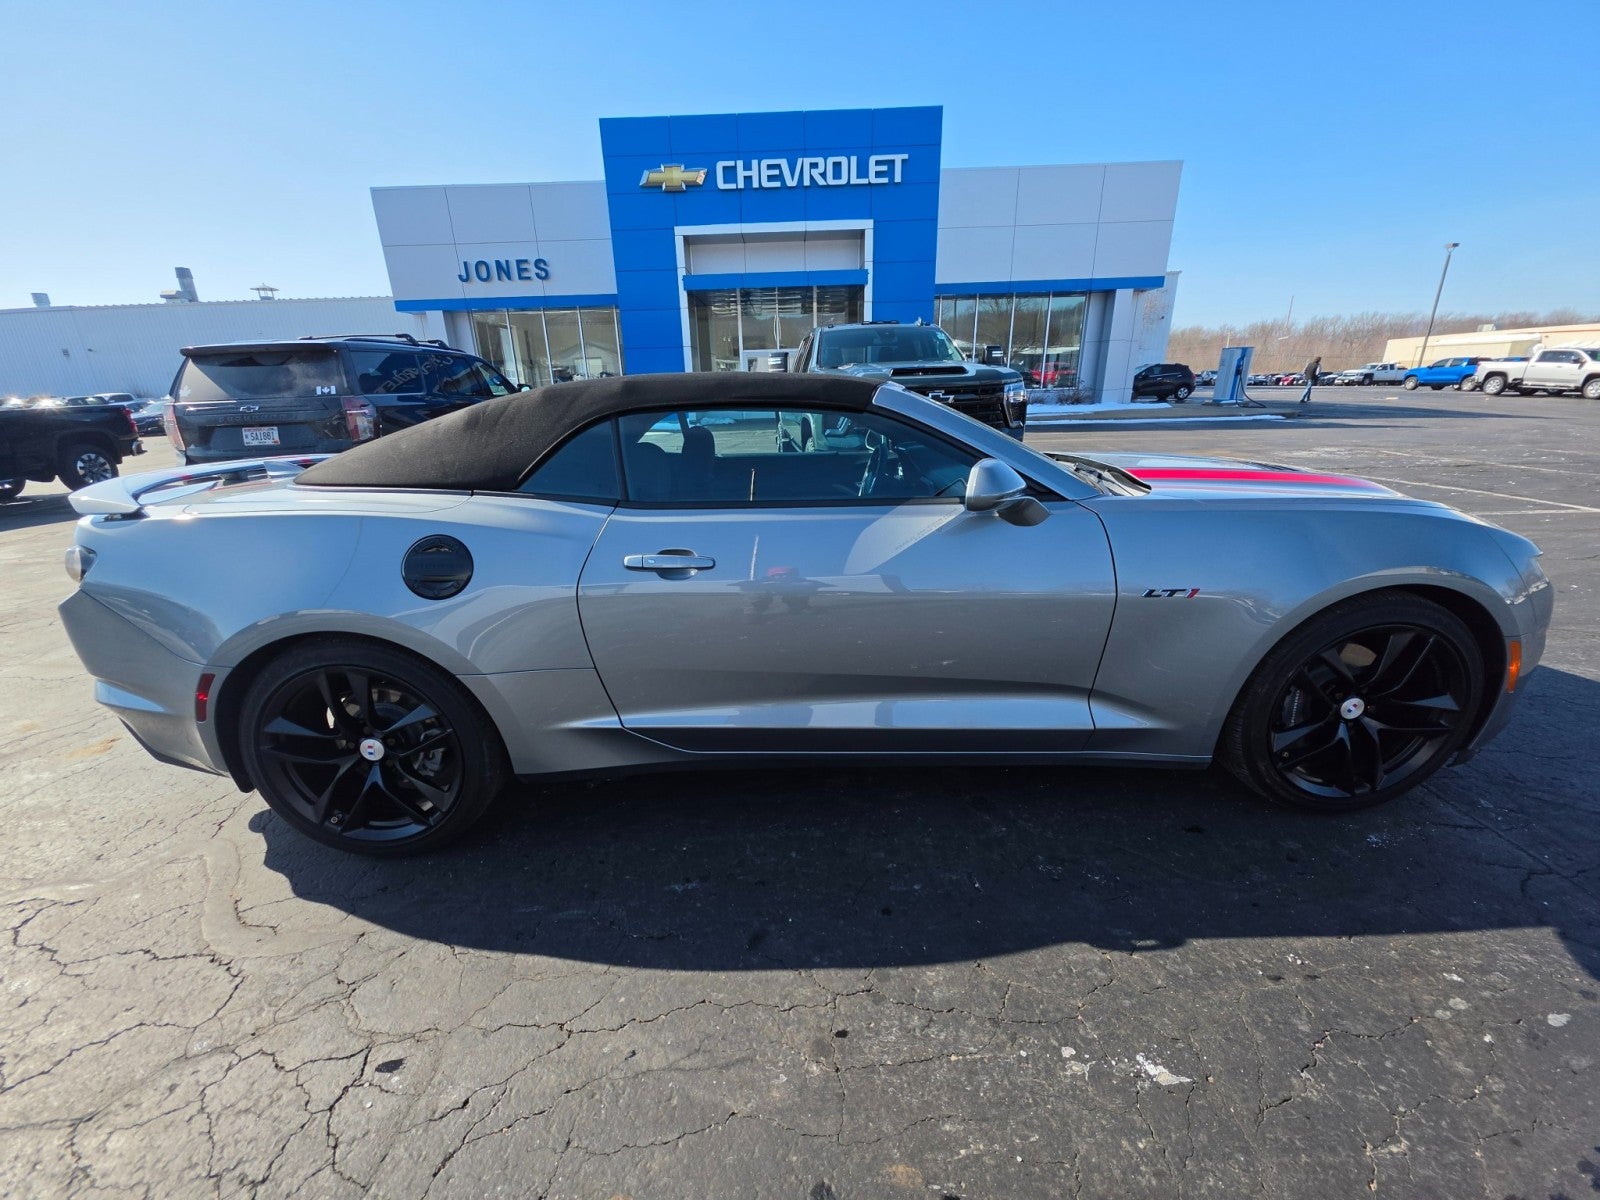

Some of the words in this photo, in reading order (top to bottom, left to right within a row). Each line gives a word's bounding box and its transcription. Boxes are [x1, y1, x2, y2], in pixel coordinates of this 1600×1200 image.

[716, 153, 909, 190] CHEVROLET
[458, 258, 550, 282] JONES
[1141, 588, 1200, 598] LT1
